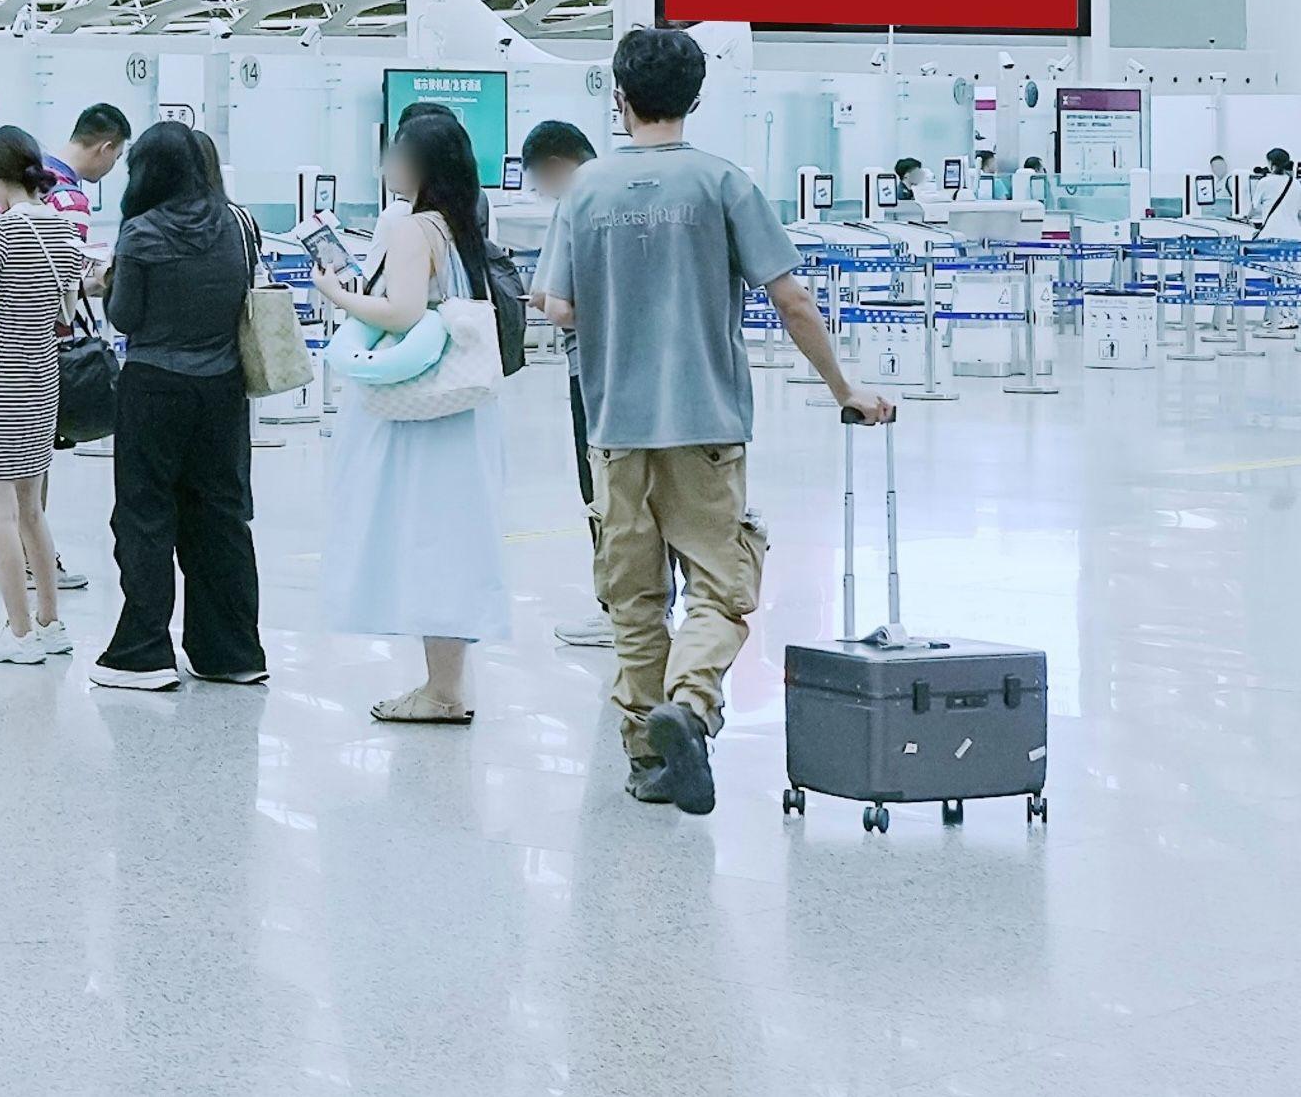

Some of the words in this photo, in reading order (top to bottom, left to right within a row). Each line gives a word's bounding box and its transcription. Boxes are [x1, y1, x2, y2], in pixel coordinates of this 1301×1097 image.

[129, 58, 147, 80] 13
[241, 62, 259, 82] 14
[589, 71, 603, 89] 15
